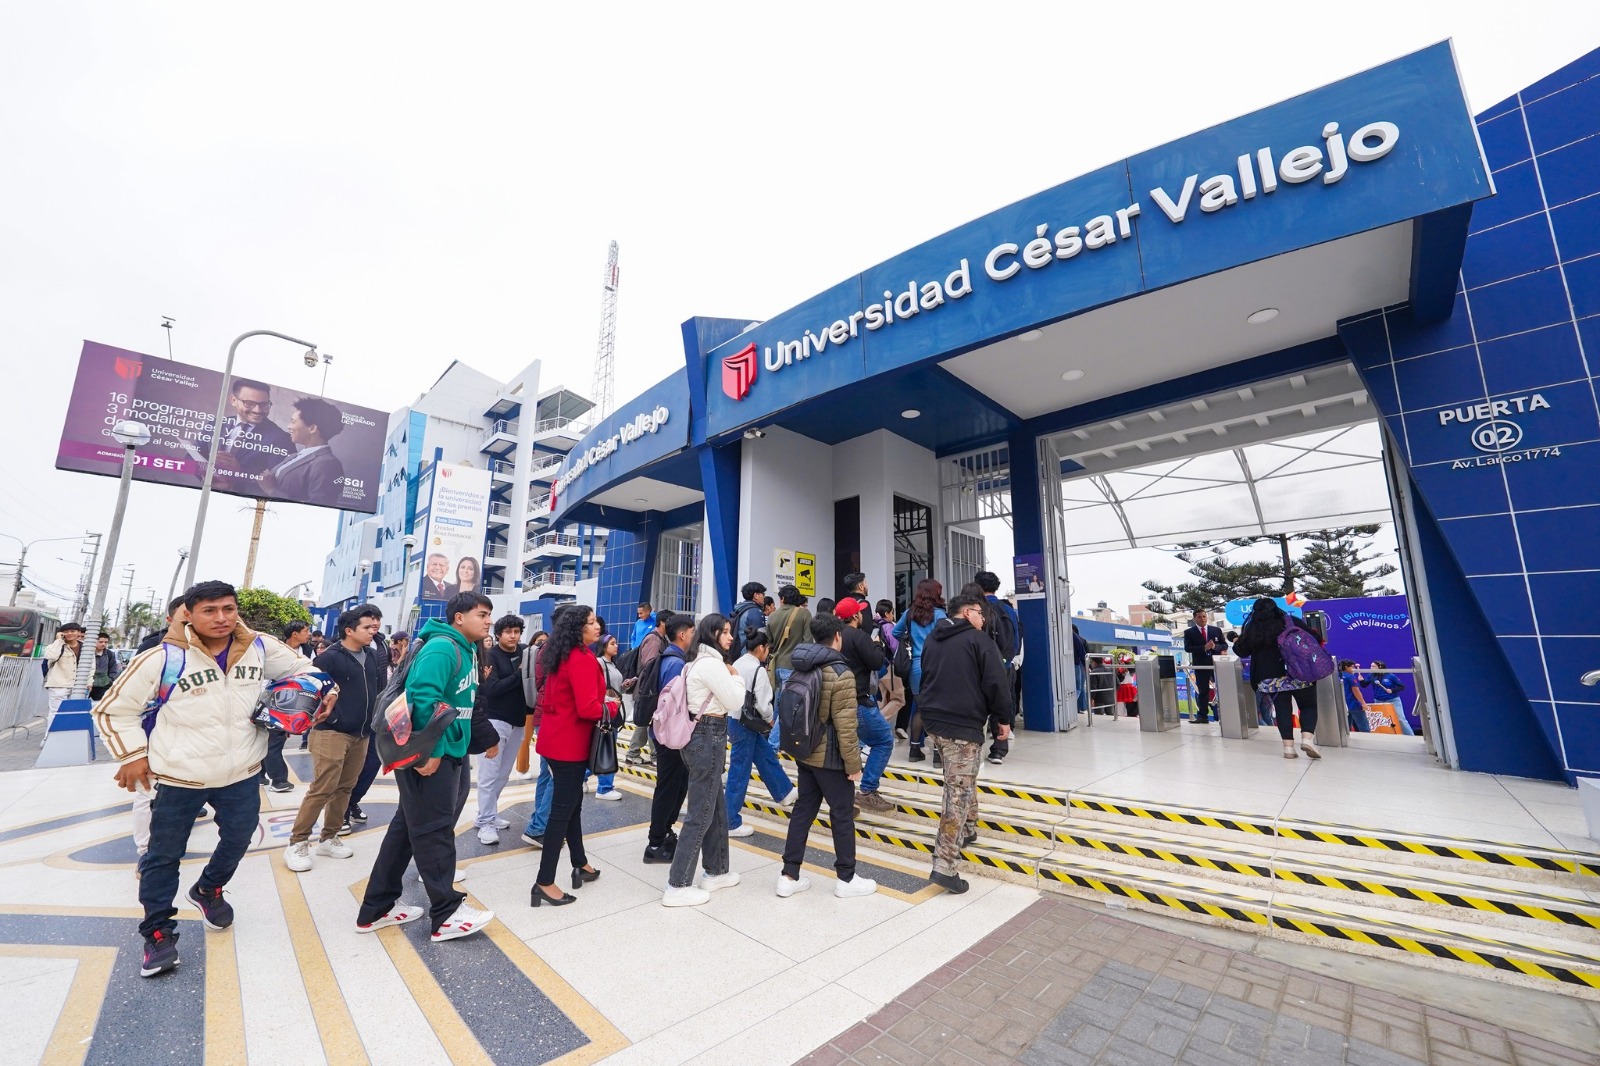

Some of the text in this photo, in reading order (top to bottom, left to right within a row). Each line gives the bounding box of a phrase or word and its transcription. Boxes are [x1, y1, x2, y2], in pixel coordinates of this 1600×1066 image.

[764, 121, 1400, 373] Universidad César Vallejo
[150, 373, 199, 388] César Vallejo
[151, 368, 195, 382] Universidad
[109, 391, 128, 404] 16
[132, 398, 215, 422] programas
[1439, 393, 1551, 426] PUERTA
[106, 403, 118, 414] 3
[224, 427, 232, 437] y
[237, 430, 262, 442] con
[341, 415, 376, 427] POSGRADO
[588, 434, 621, 466] César
[620, 405, 670, 445] Vallejo
[1479, 427, 1516, 446] 02
[133, 455, 149, 466] 01
[153, 457, 185, 471] SET
[1451, 447, 1562, 470] Av. Larco 1774
[217, 468, 233, 477] 966
[234, 471, 248, 479] 841
[344, 477, 364, 488] SGI
[445, 495, 482, 505] universidad
[457, 503, 482, 512] premios
[178, 668, 220, 693] BUR
